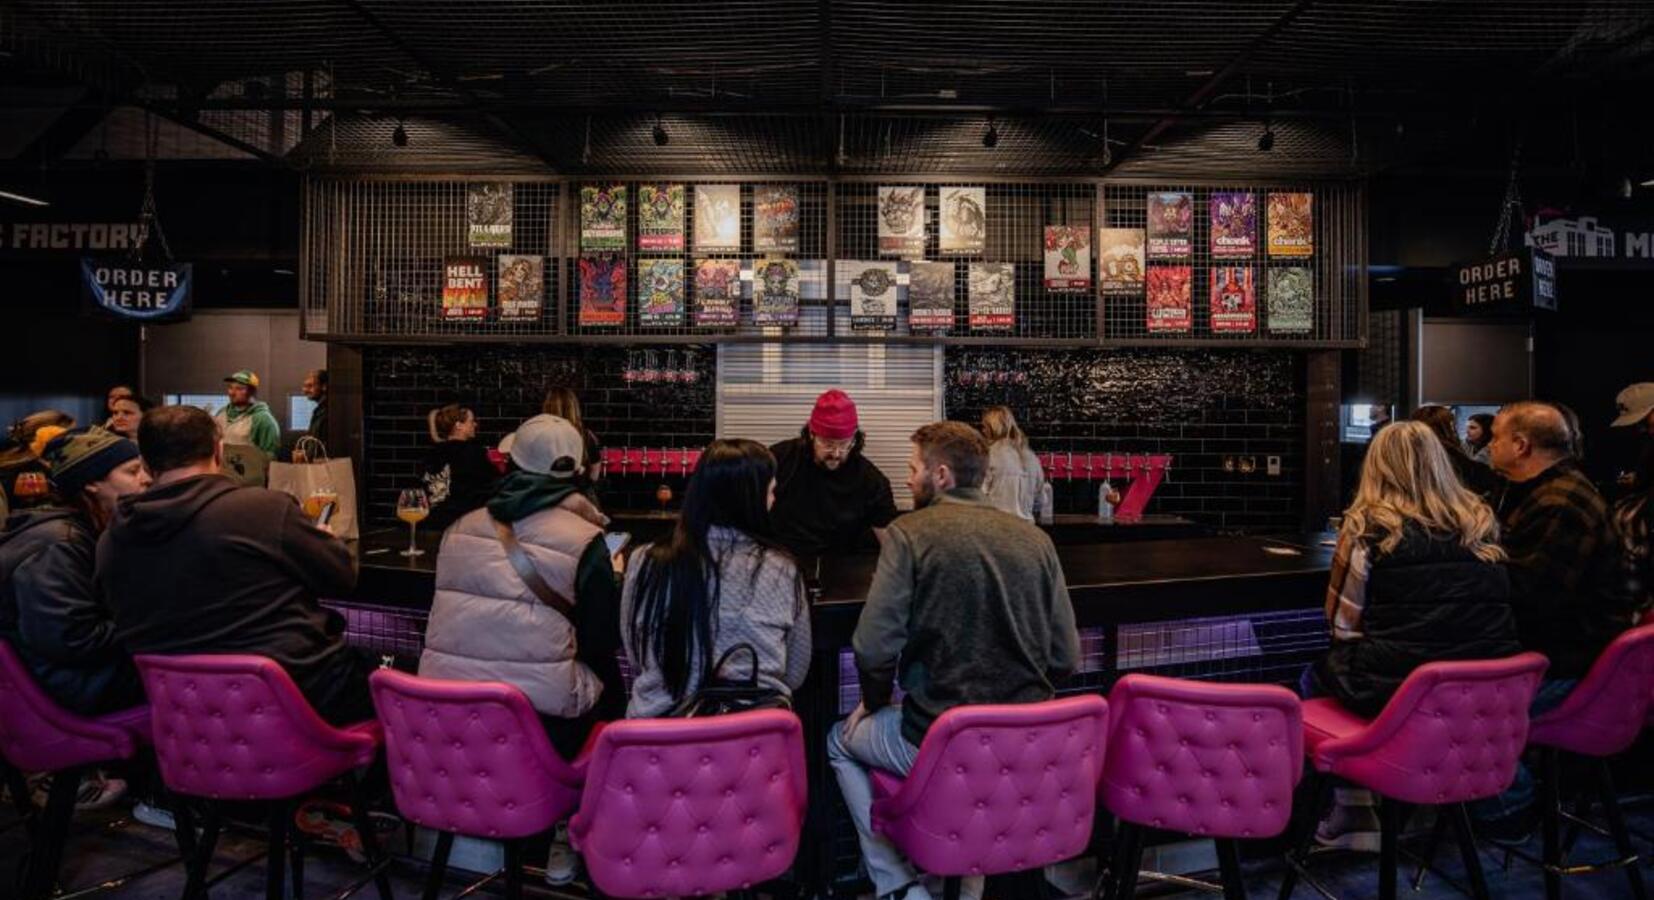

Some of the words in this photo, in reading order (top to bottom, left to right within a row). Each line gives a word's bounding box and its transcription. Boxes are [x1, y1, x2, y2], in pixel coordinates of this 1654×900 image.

[12, 223, 149, 249] FACTORY
[1534, 231, 1559, 245] THE
[95, 267, 178, 288] ORDER
[447, 265, 484, 277] HELL
[1459, 257, 1521, 286] ORDER
[448, 278, 484, 289] BENT
[1465, 281, 1515, 306] HERE
[103, 290, 168, 309] HERE
